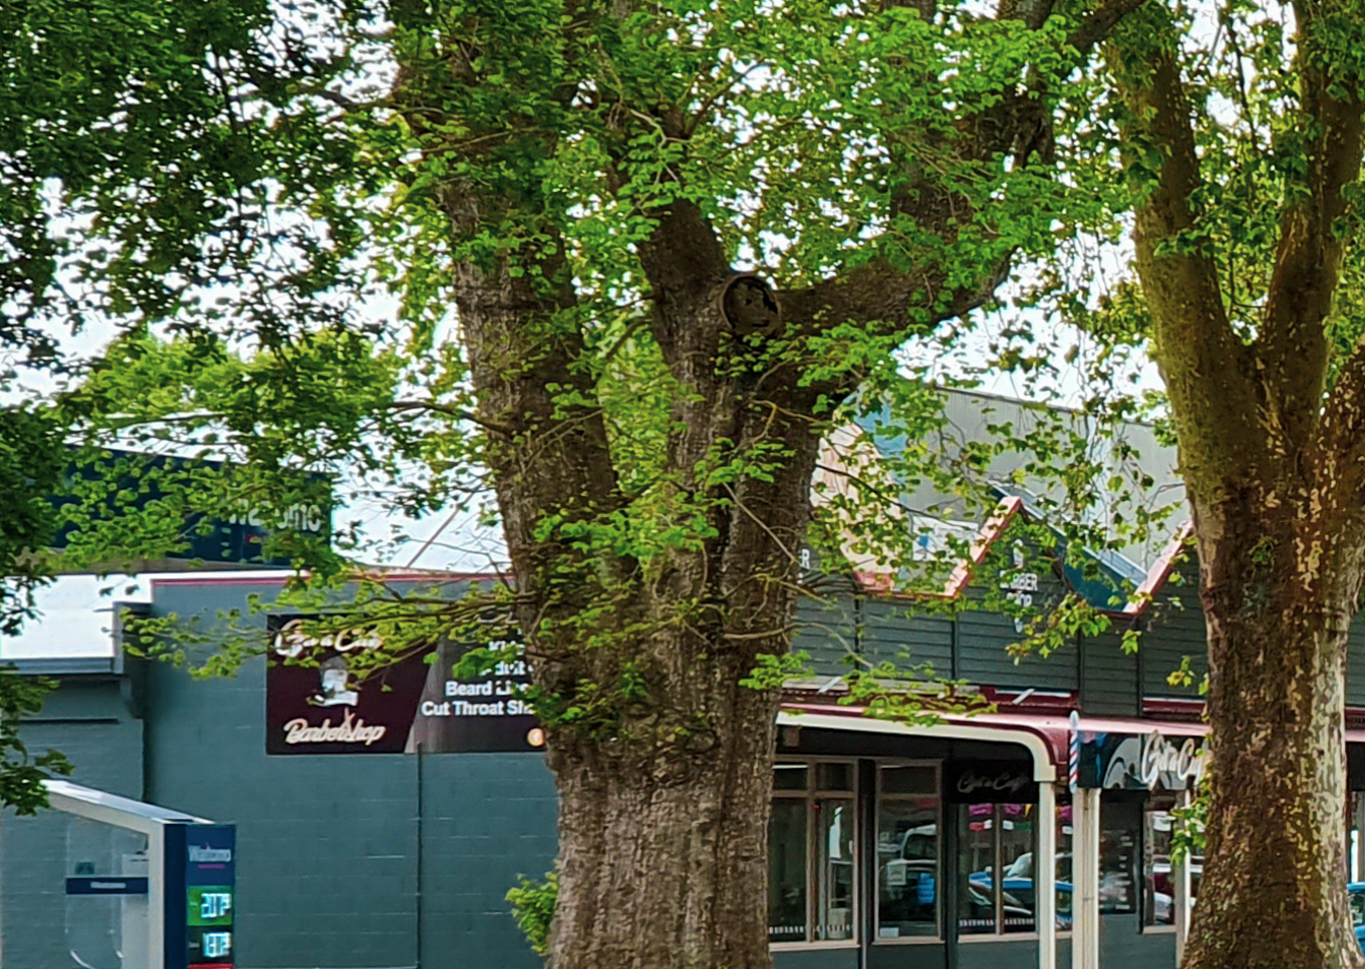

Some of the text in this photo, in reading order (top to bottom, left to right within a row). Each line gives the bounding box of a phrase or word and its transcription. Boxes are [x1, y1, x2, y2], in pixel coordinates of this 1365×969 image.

[446, 681, 492, 696] Beard
[421, 702, 449, 716] Cut
[452, 702, 503, 716] Throat
